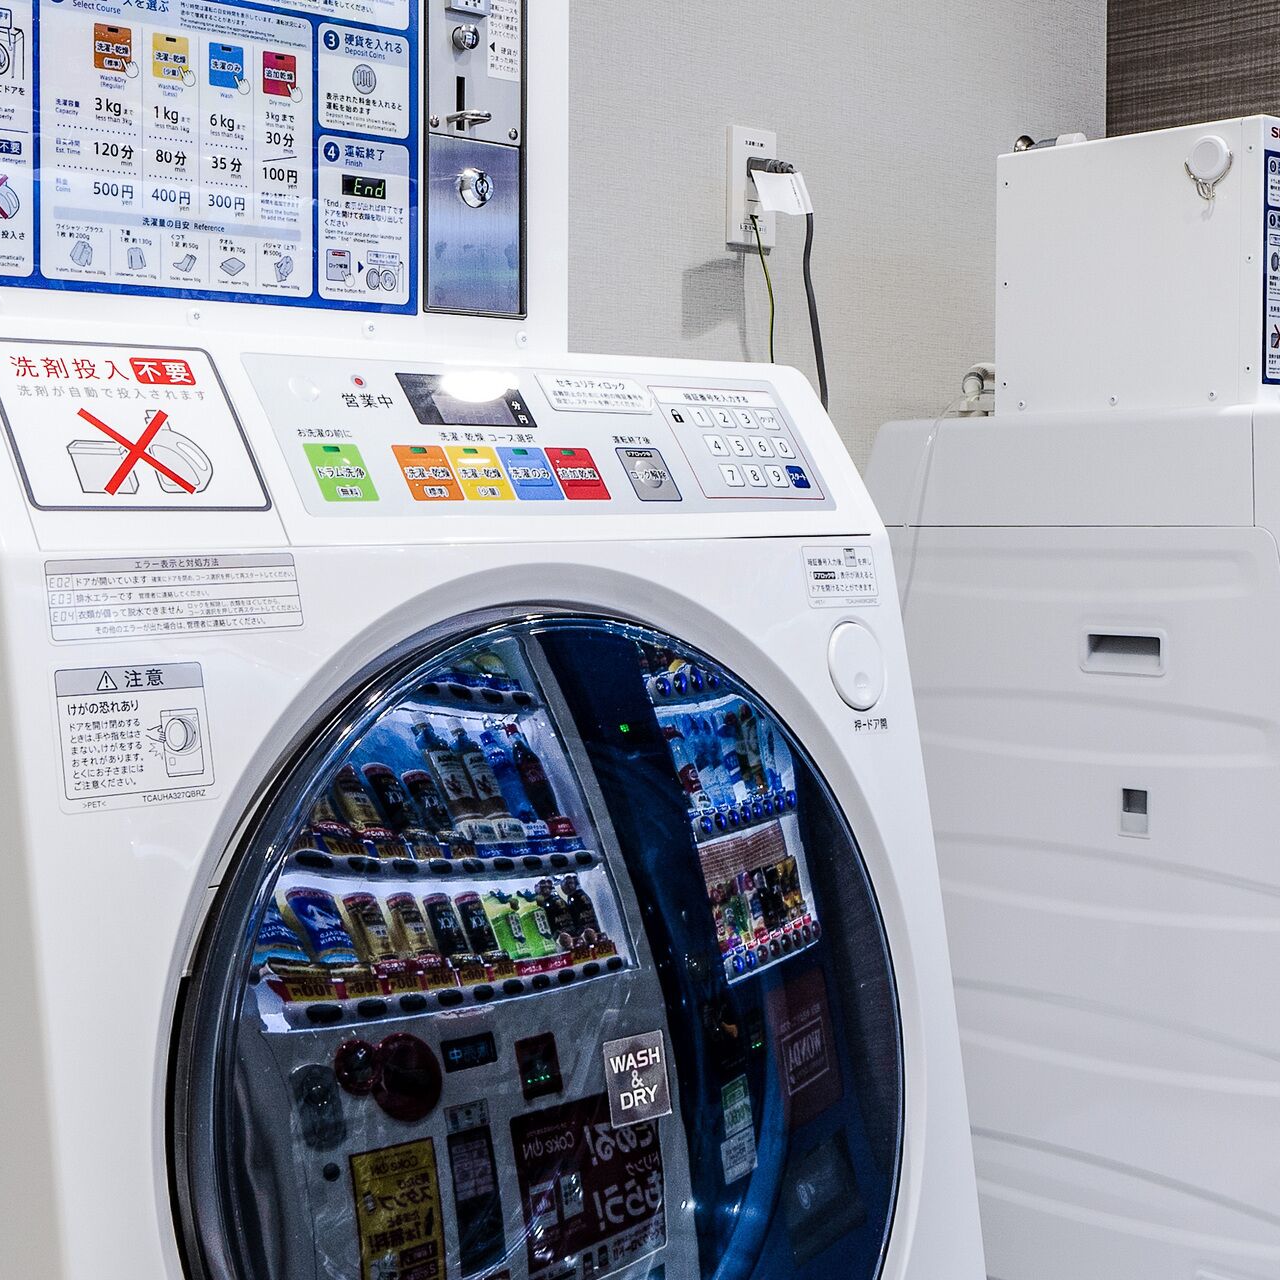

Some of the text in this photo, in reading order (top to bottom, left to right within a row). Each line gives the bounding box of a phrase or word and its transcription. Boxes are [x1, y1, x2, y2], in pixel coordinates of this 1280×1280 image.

[97, 2, 121, 14] Course
[344, 33, 402, 54] 硬貨を入れる
[345, 47, 385, 60] Deposit Coins
[212, 61, 241, 72] 洗濯のみ
[326, 92, 402, 111] 表示された料金を入れると
[326, 102, 371, 115] 運転を始めます
[0, 141, 20, 154] 不要
[345, 144, 384, 161] 運転終了
[345, 159, 362, 168] Finish
[354, 178, 384, 198] End
[324, 210, 404, 224] ドアを開けて衣類を取り出して
[142, 217, 224, 232] 洗濯量の目安 Reference
[10, 356, 194, 384] 洗剤投入 不要
[556, 379, 624, 390] セキュリティロック
[17, 384, 206, 402] 洗剤が自動で投入されます
[684, 393, 748, 402] 暗証番号を入力する
[342, 392, 394, 409] 営業中
[512, 400, 522, 410] 分
[518, 414, 528, 424] 円
[720, 412, 728, 423] 2
[742, 414, 750, 424] 3
[297, 428, 352, 438] お洗濯の前に
[489, 433, 536, 443] コース選択
[736, 440, 744, 451] 5
[758, 441, 766, 452] 6
[780, 442, 788, 452] 0
[318, 467, 365, 479] ドラム洗浄
[512, 467, 551, 479] 洗濯のみ
[558, 468, 598, 479] 追加乾燥
[631, 470, 667, 480] ロック解除
[750, 470, 760, 481] 8
[773, 470, 780, 482] 9
[134, 558, 220, 569] エラー表示と対処方法
[50, 593, 72, 605] E03
[76, 591, 133, 603] 排水エラーです
[124, 668, 164, 688] 注意
[67, 700, 139, 716] けがの恐れあり
[69, 718, 140, 732] ドアを開け閉めする
[70, 729, 142, 744] ときは、手や指をはさ
[72, 753, 144, 768] おそれがあります。
[72, 765, 144, 780] とくにお子さまには
[74, 778, 137, 791] ご注意ください。
[610, 1046, 660, 1074] WASH
[632, 1070, 644, 1088] &
[620, 1084, 658, 1110] DRY
